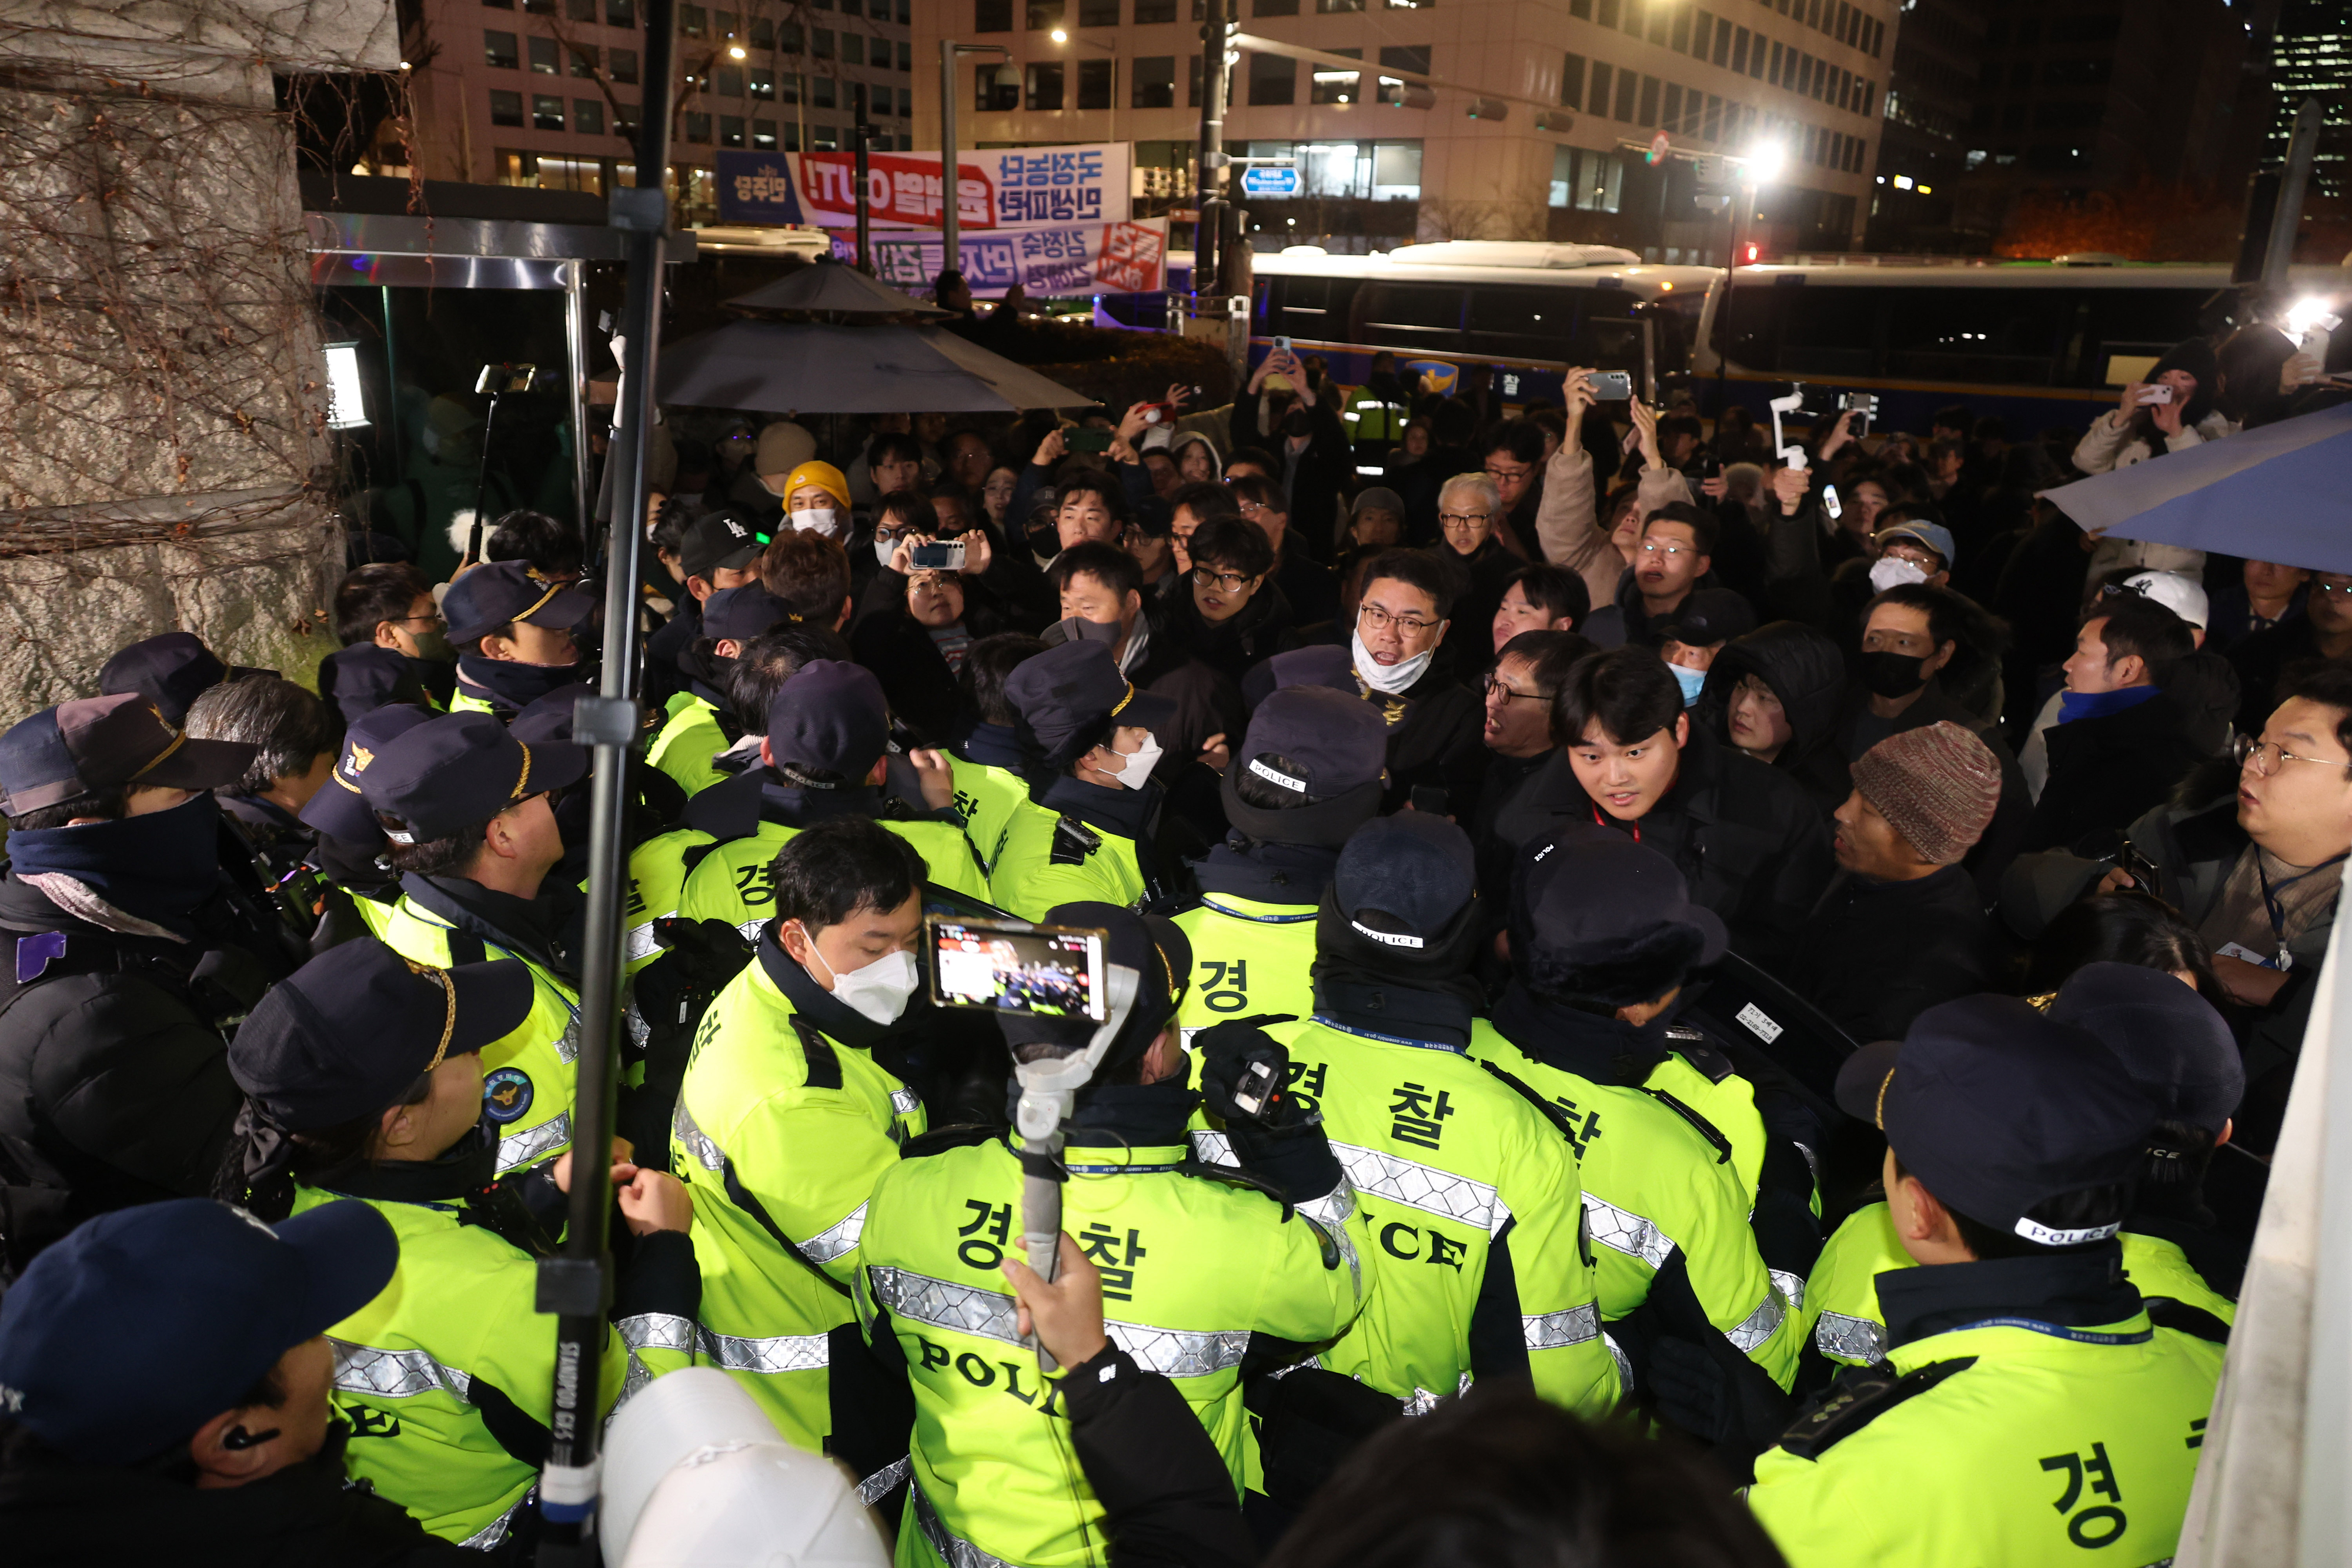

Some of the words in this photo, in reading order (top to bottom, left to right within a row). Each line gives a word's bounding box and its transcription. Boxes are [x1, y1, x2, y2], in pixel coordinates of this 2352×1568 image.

[1502, 373, 1520, 396] 찰
[723, 519, 747, 538] LA
[788, 771, 834, 788] POLICE
[1254, 764, 1300, 790] POLICE
[1534, 843, 1555, 862] POLICE
[736, 860, 775, 906] 경
[1361, 929, 1418, 946] OLICE
[1199, 959, 1248, 1012] 경
[1364, 1033, 1412, 1045] www.assembly.go.kr
[1288, 1061, 1328, 1116] 경
[1389, 1081, 1455, 1151] 찰
[2030, 1221, 2119, 1245] POLICE
[958, 1198, 1012, 1271] 경
[1078, 1222, 1147, 1302] 찰
[918, 1335, 1063, 1417] POLI
[2039, 1441, 2127, 1550] 경
